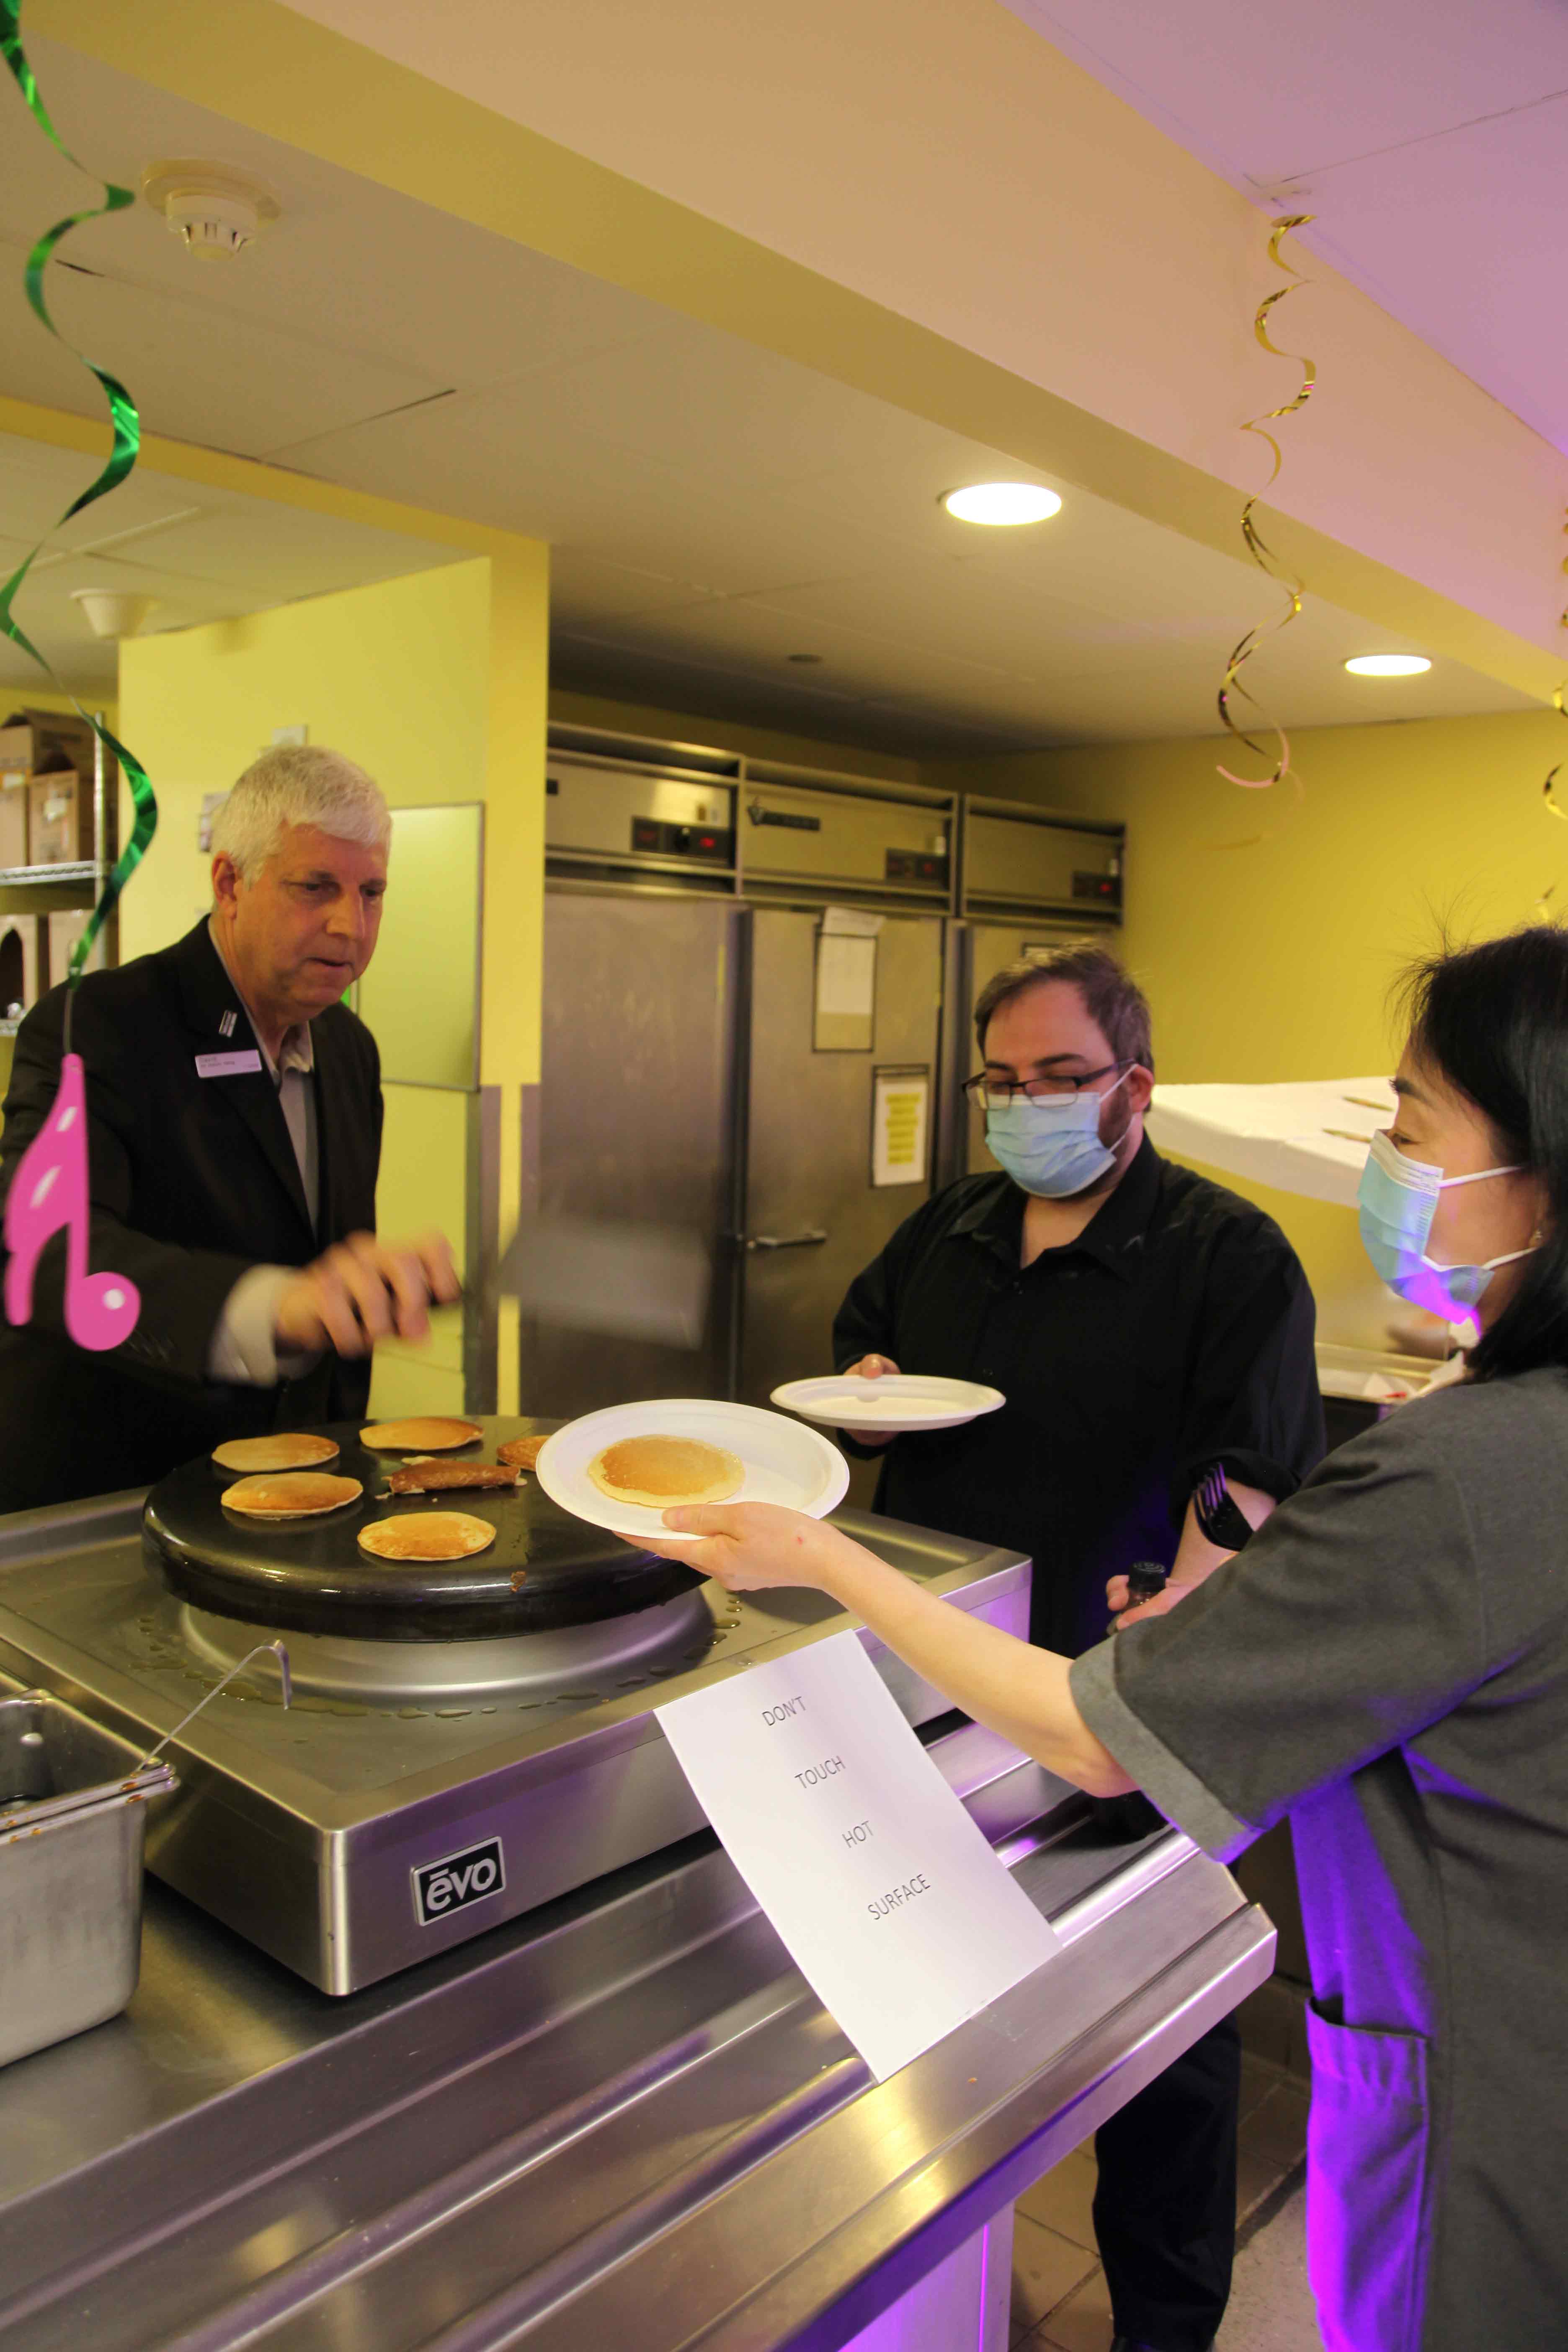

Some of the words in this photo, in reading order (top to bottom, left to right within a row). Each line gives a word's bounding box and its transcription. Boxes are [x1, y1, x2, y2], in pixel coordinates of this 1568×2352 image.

[794, 1755, 846, 1789] TOUCH
[841, 1820, 873, 1848] HOT
[867, 1873, 931, 1920] SURFACE
